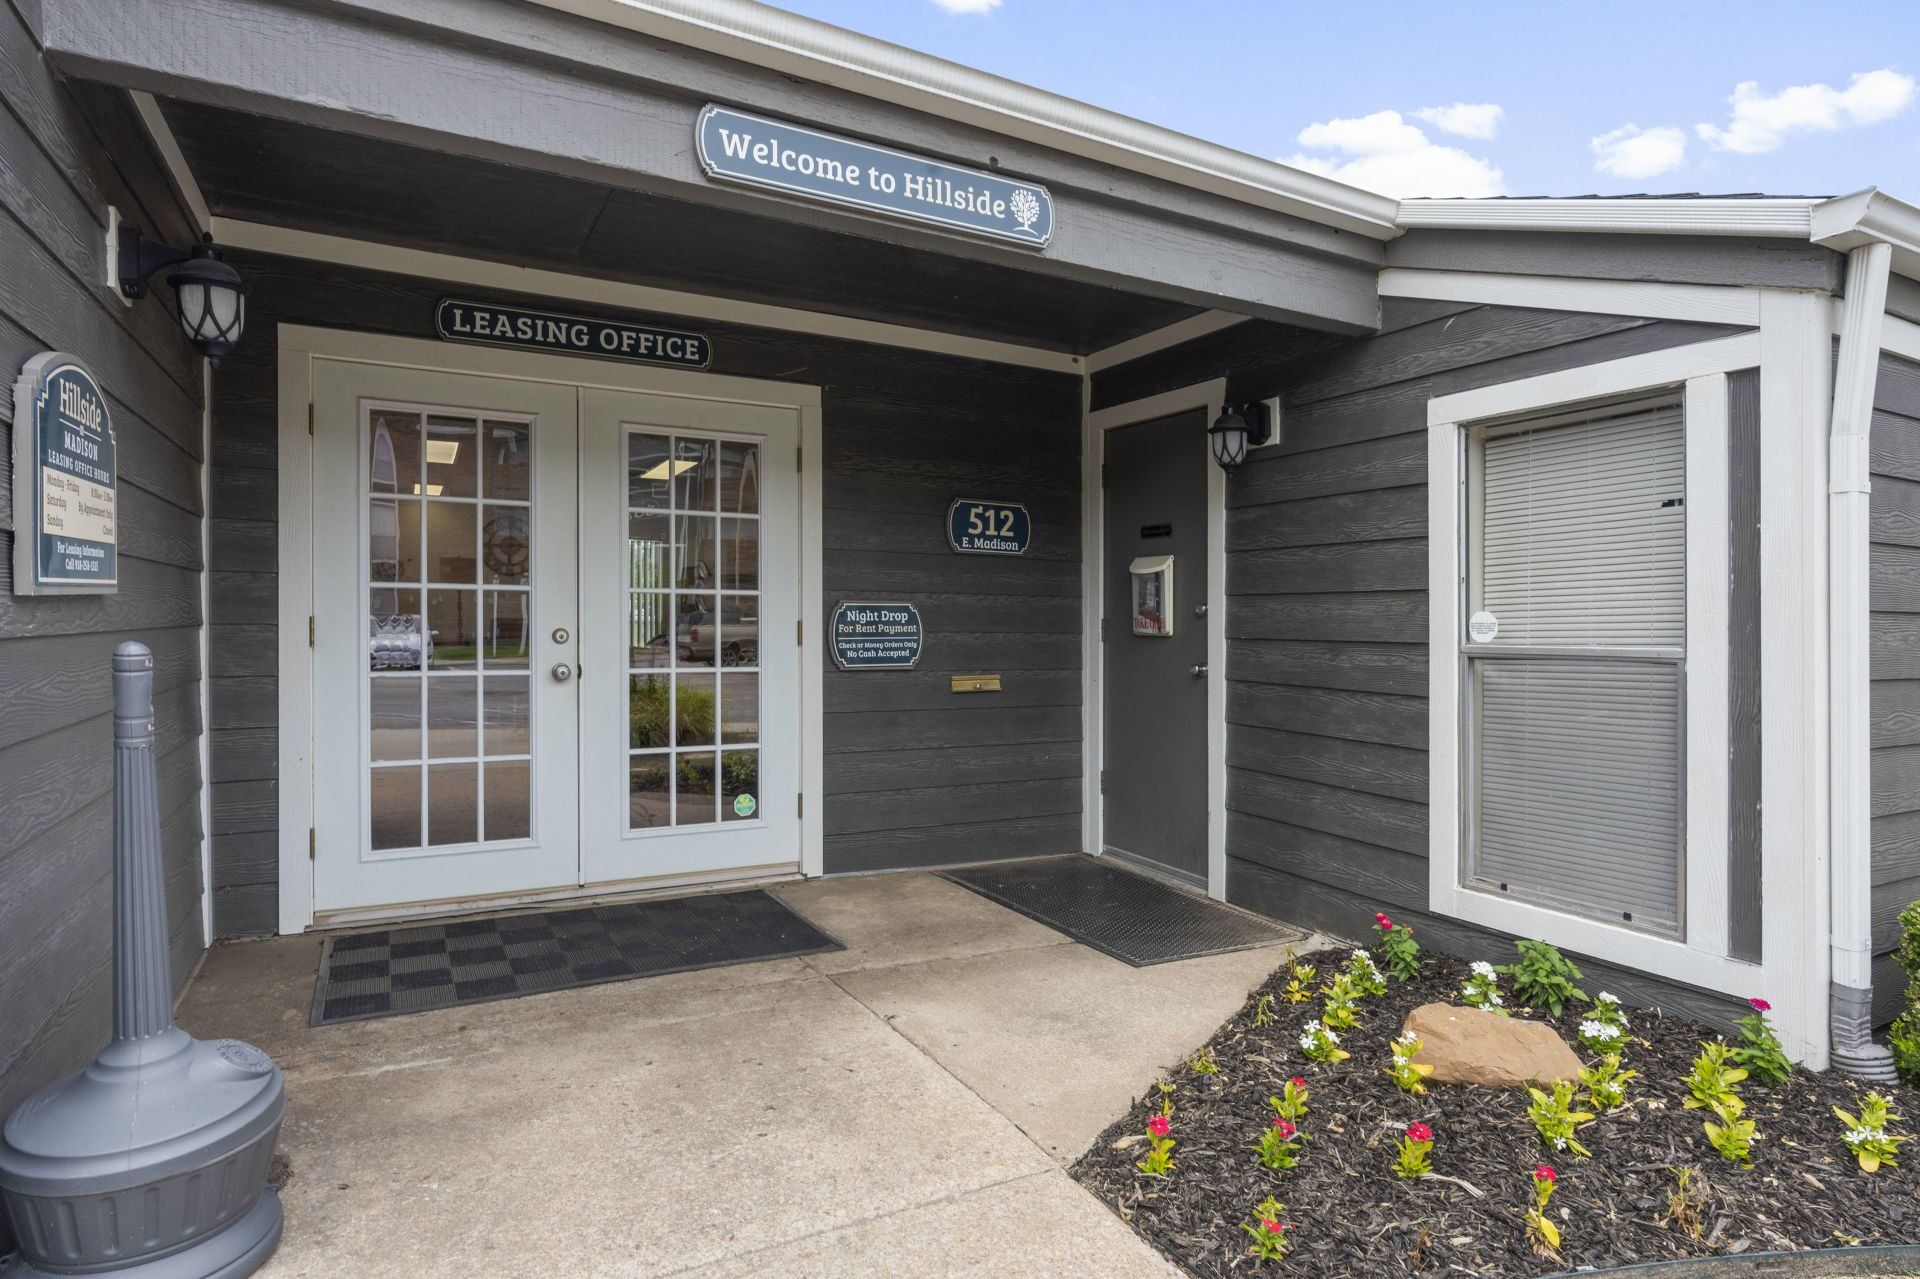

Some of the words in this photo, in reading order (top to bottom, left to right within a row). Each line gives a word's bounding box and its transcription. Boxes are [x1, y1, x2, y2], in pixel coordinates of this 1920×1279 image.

[718, 128, 861, 186] Welcome
[867, 167, 896, 194] to
[903, 172, 1006, 219] Hillside
[453, 308, 590, 347] LEASING
[599, 328, 700, 361] OFFICE
[59, 377, 102, 433] Hillside
[64, 430, 98, 462] MADISON
[48, 449, 74, 471] LEASING
[75, 460, 93, 478] OFFICE
[94, 468, 110, 483] HOURS
[968, 505, 1014, 537] 512
[962, 537, 972, 548] E.
[974, 537, 1019, 551] Madison
[838, 624, 854, 633] For
[855, 624, 876, 633] Rent
[878, 624, 917, 635] Payment
[847, 610, 879, 624] Night
[881, 610, 908, 624] Drop
[847, 650, 857, 658] No
[858, 649, 876, 658] Cash
[877, 649, 910, 658] Accepted
